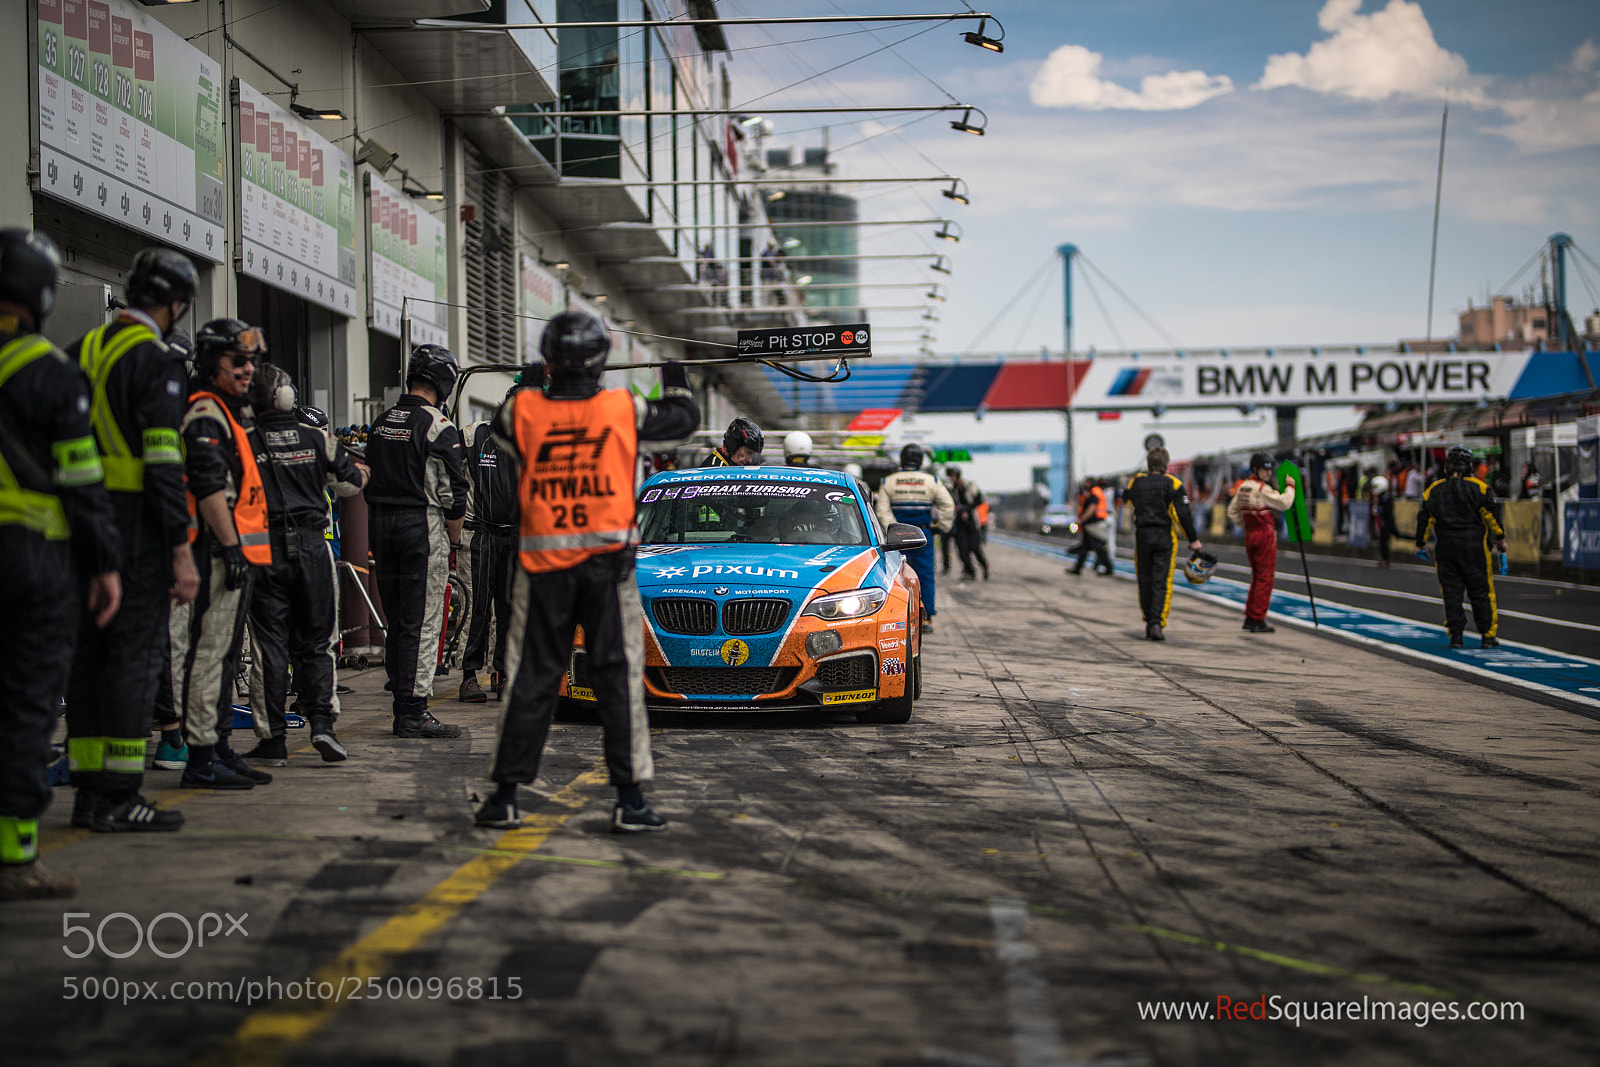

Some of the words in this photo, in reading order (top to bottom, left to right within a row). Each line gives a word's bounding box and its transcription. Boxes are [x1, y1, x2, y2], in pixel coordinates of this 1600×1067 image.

[45, 32, 57, 67] 35
[69, 47, 85, 82] 127
[93, 62, 109, 97] 128
[116, 74, 131, 110] 702
[138, 87, 152, 121] 704
[214, 187, 222, 221] 30
[769, 335, 788, 348] Pit
[791, 333, 835, 347] STOP
[1198, 365, 1292, 394] BMW
[1305, 364, 1338, 393] M
[1351, 362, 1491, 393] POWER
[530, 475, 615, 500] PITWALL
[658, 474, 838, 485] ADRENALIN-RENNTAXI
[699, 485, 742, 494] GRAN
[744, 485, 812, 495] TURISMO
[552, 504, 588, 529] 26
[692, 565, 798, 579] pixum
[691, 648, 720, 657] BILSTEIN
[833, 691, 875, 702] DUNLOP
